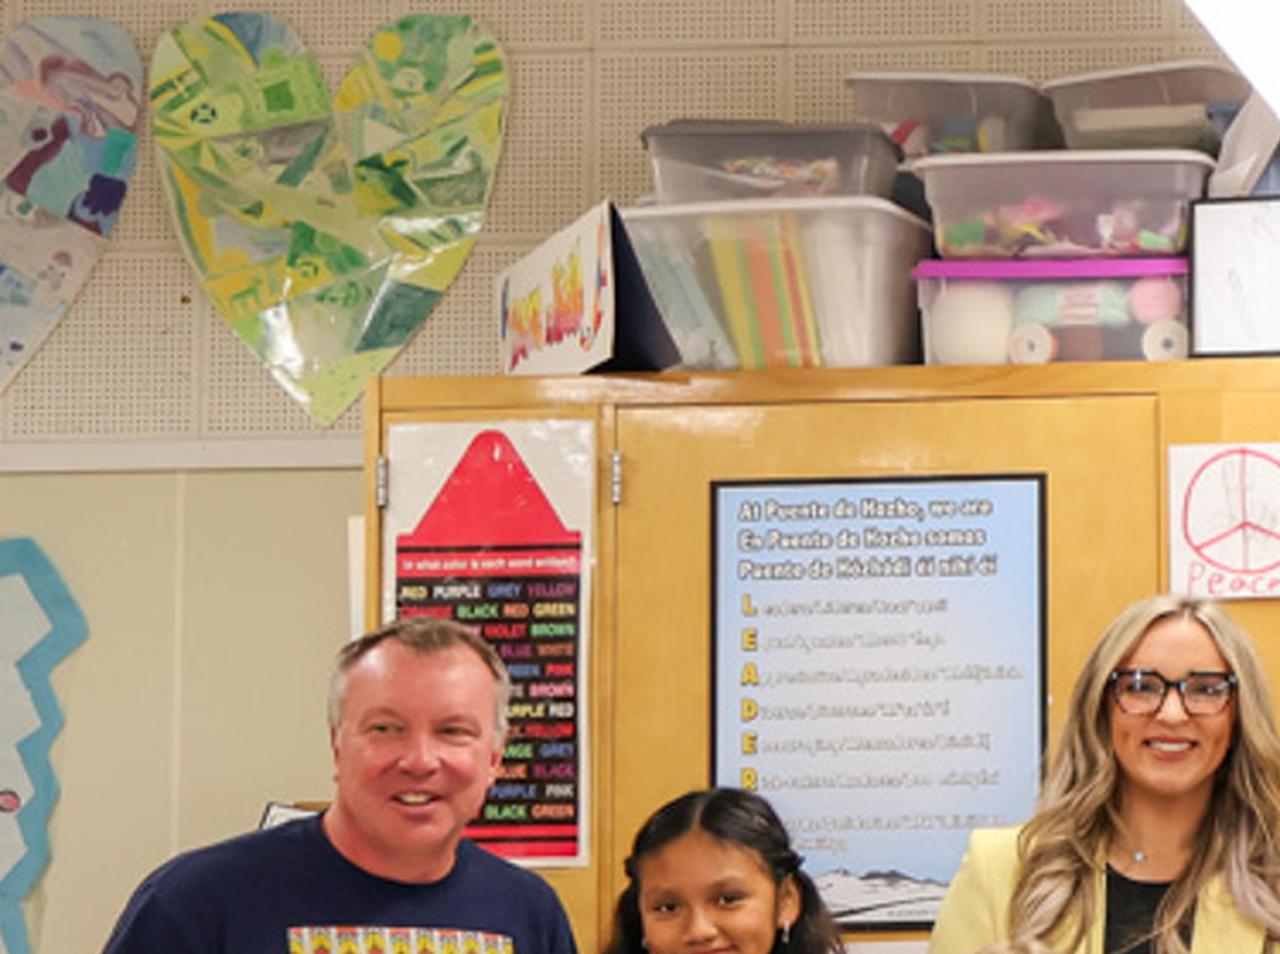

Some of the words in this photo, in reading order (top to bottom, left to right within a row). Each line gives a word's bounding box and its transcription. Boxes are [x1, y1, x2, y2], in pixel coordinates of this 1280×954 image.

[432, 584, 482, 599] PURPLE
[456, 604, 499, 619] BLACK
[532, 602, 577, 618] GREEN
[741, 593, 759, 618] L
[740, 627, 759, 652] E
[740, 662, 760, 687] A
[506, 702, 546, 718] URPLE
[740, 697, 760, 722] D
[740, 731, 759, 755] E
